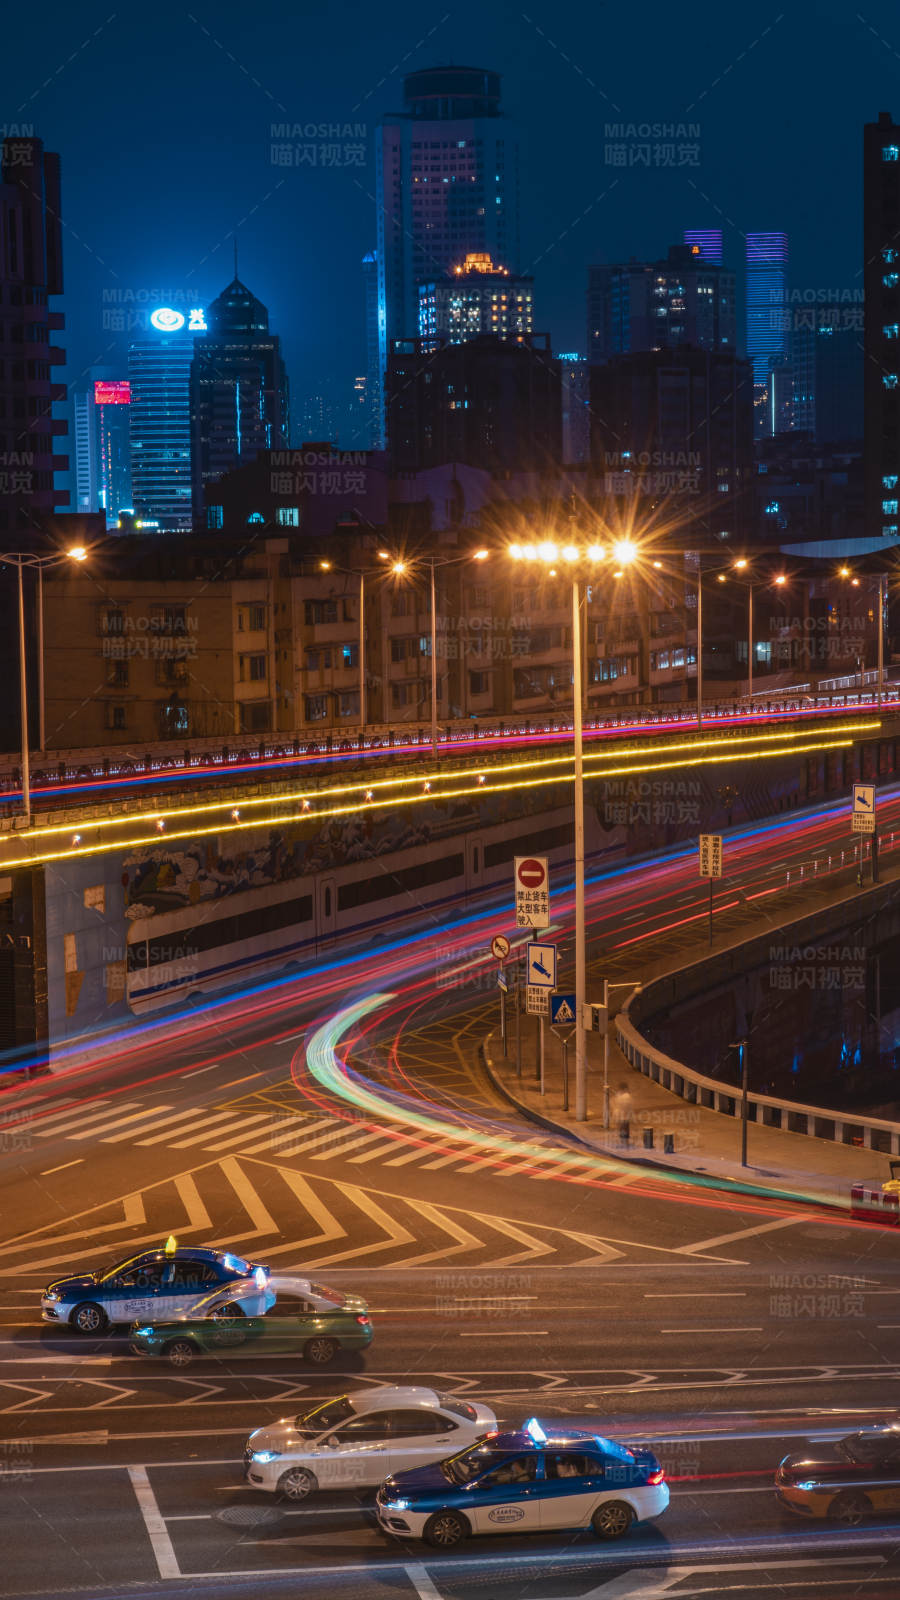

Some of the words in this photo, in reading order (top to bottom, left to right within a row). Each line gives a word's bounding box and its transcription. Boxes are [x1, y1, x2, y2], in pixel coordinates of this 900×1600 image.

[517, 890, 548, 902] 禁止货车
[517, 903, 548, 914] 大型客车
[517, 915, 533, 926] 驶入
